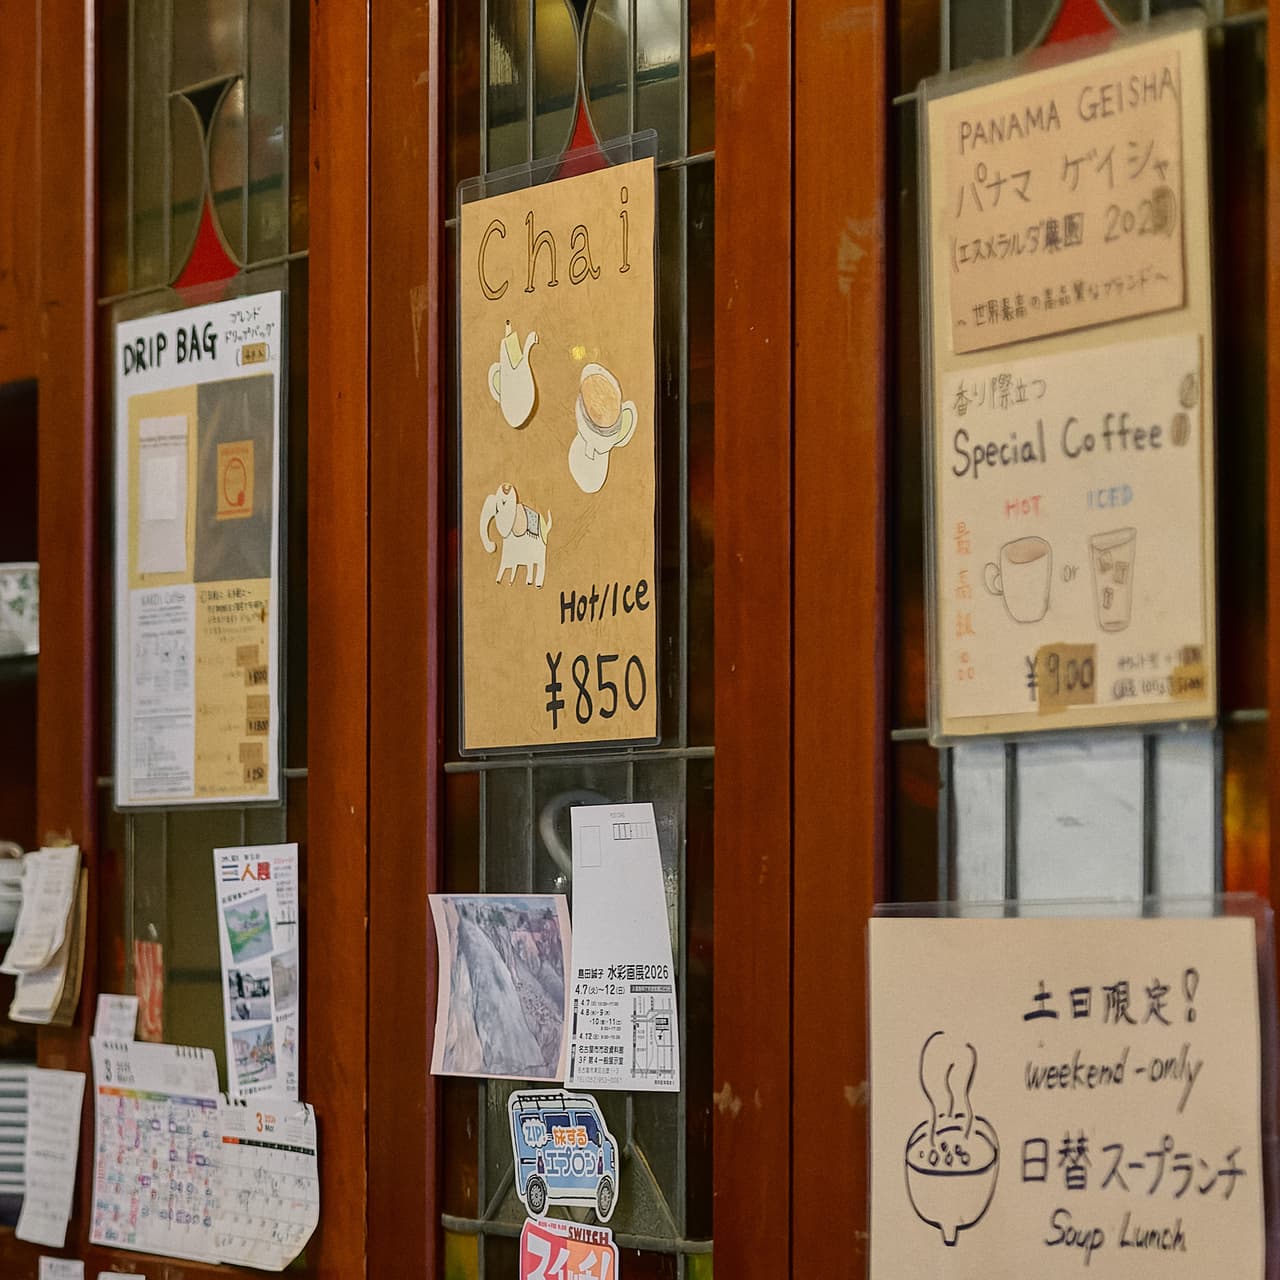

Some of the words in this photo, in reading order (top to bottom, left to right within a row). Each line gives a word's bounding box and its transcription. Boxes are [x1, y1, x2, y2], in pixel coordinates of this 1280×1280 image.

[960, 100, 1061, 156] PANAMA
[1079, 67, 1179, 122] GEISHA
[956, 161, 1031, 219] パナマ
[1062, 139, 1170, 191] ゲイシャ
[478, 186, 631, 300] Chai
[124, 332, 168, 376] DRIP
[177, 321, 218, 364] BAG
[952, 418, 1047, 479] Special
[1062, 411, 1163, 459] Coffee
[1005, 494, 1042, 518] HOT
[1062, 564, 1080, 583] or
[560, 579, 650, 624] Hot/Ice
[545, 651, 647, 730] ¥850
[1024, 652, 1096, 702] ¥900
[607, 964, 670, 981] 水彩画展2026
[545, 1146, 596, 1176] エプロン
[1022, 1127, 1248, 1201] 日替スープランチ
[568, 1225, 609, 1245] SWITCH
[1044, 1207, 1106, 1267] Soup
[1119, 1209, 1188, 1253] Lunch
